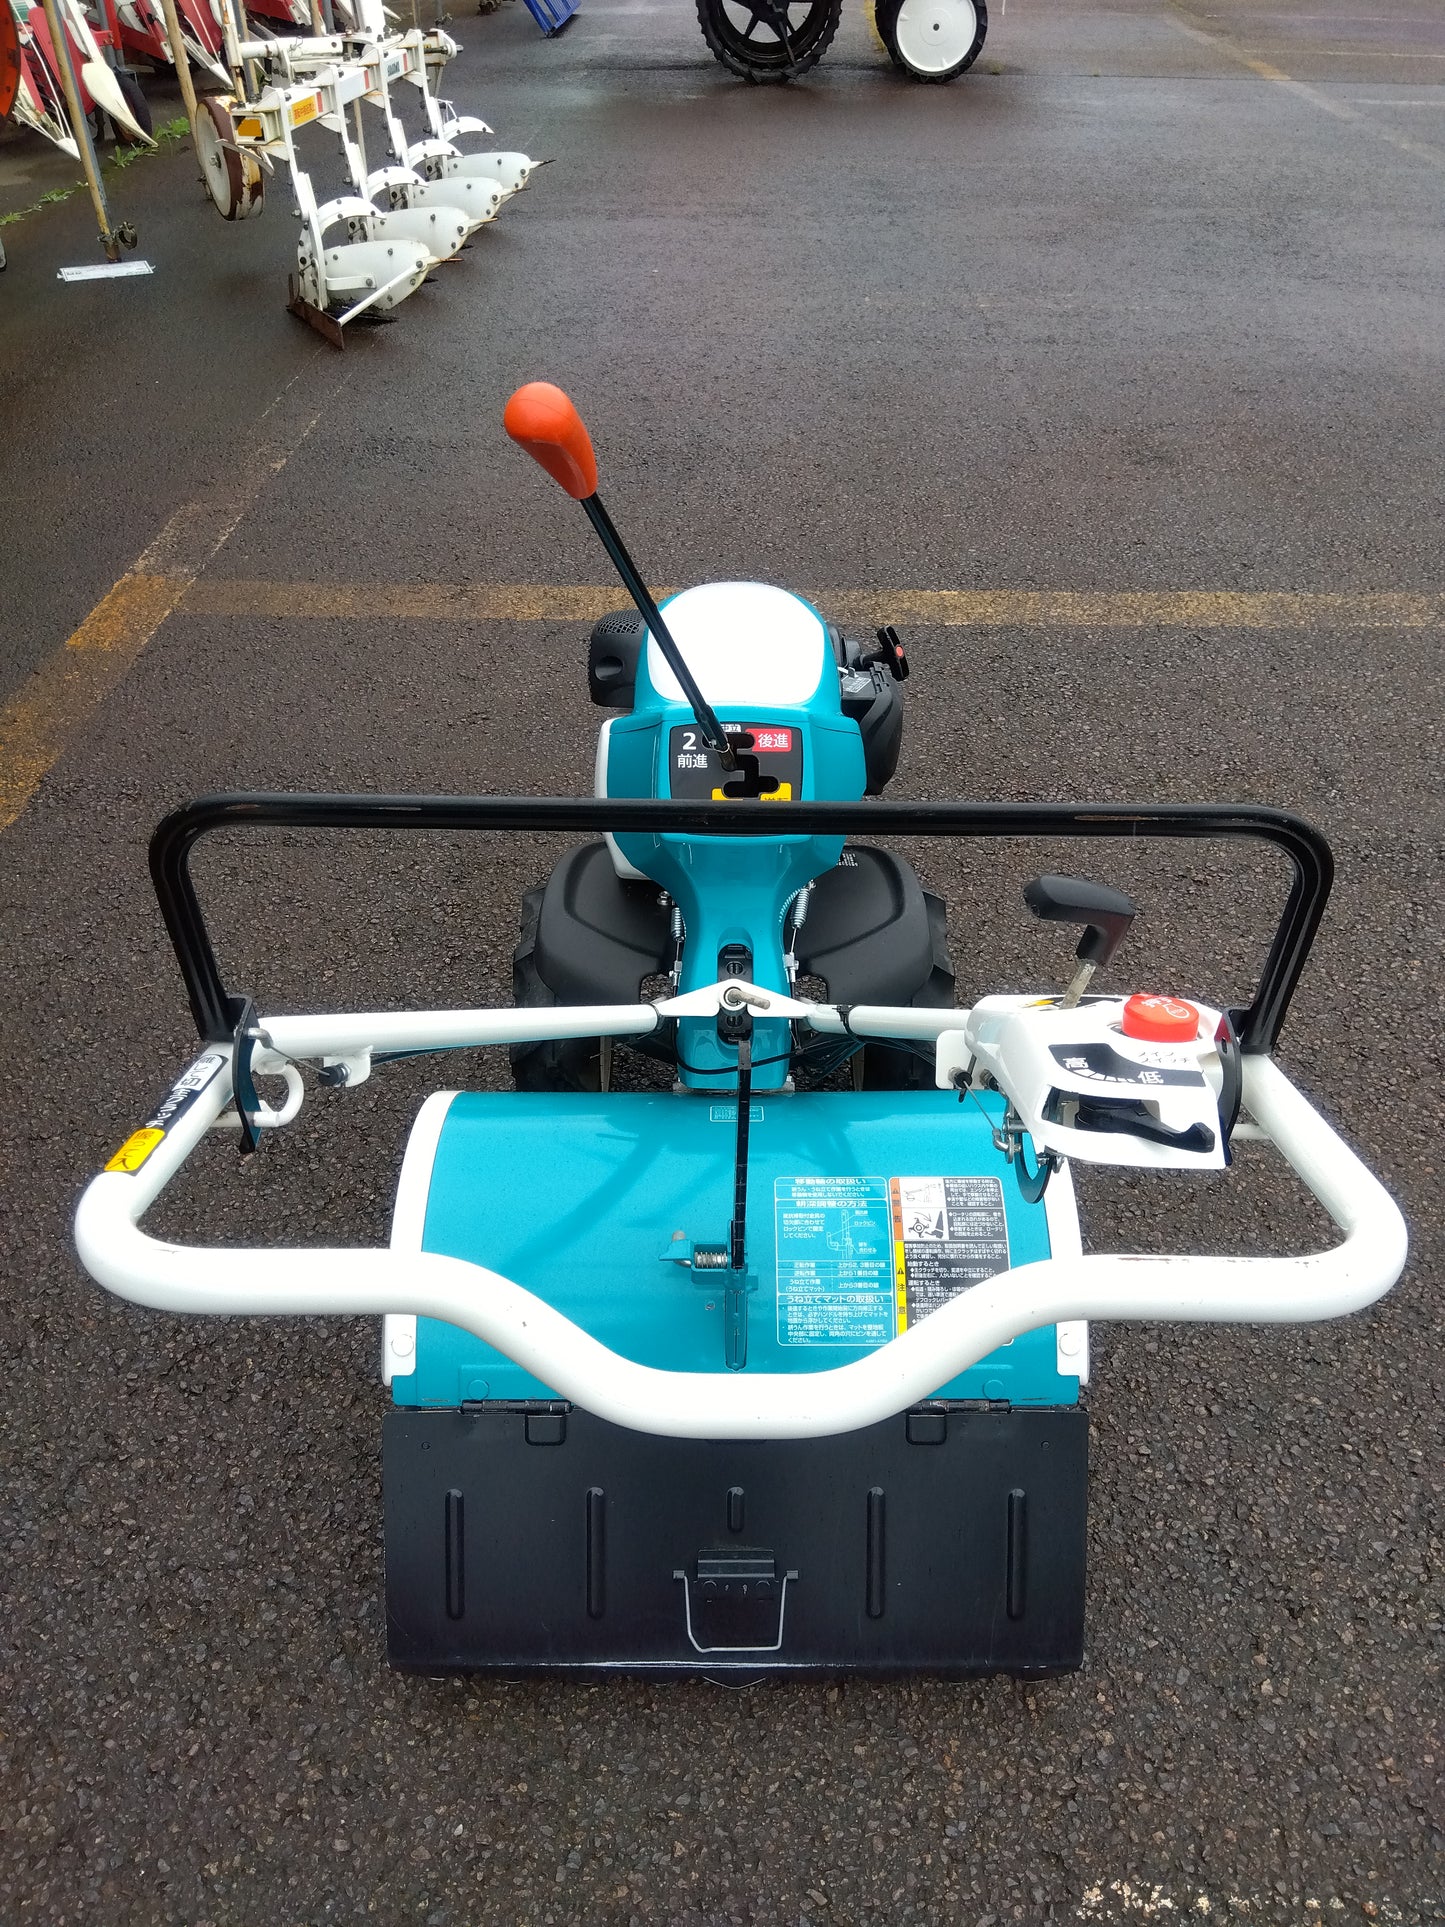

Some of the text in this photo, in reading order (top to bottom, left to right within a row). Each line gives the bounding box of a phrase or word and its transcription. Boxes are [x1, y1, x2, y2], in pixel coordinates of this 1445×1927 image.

[682, 732, 698, 751] 2
[758, 733, 789, 749] 後進
[677, 753, 708, 769] 前進
[1063, 1056, 1089, 1070] 高
[1137, 1070, 1165, 1084] 低
